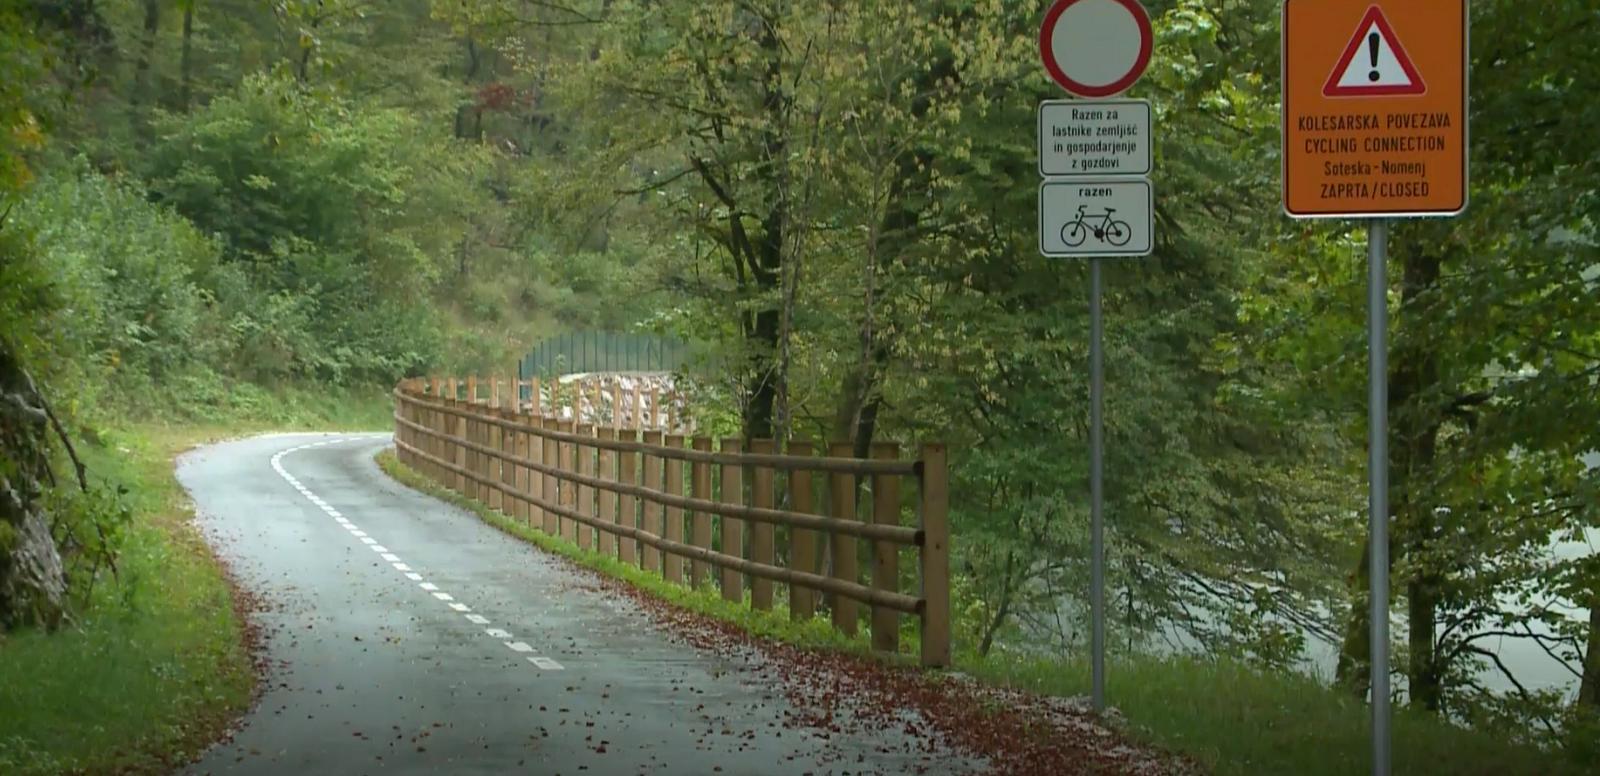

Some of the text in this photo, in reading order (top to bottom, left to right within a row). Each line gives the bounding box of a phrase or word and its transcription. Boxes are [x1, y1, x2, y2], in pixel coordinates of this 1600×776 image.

[1072, 108, 1119, 120] Razen za
[1298, 112, 1451, 131] KOLESARSKA POVEZAVA
[1052, 125, 1092, 137] lastnike
[1054, 141, 1136, 155] in gospodarjenje
[1305, 135, 1445, 154] CYCLING CONNECTION
[1081, 157, 1119, 171] gozdovi
[1079, 187, 1112, 197] razen
